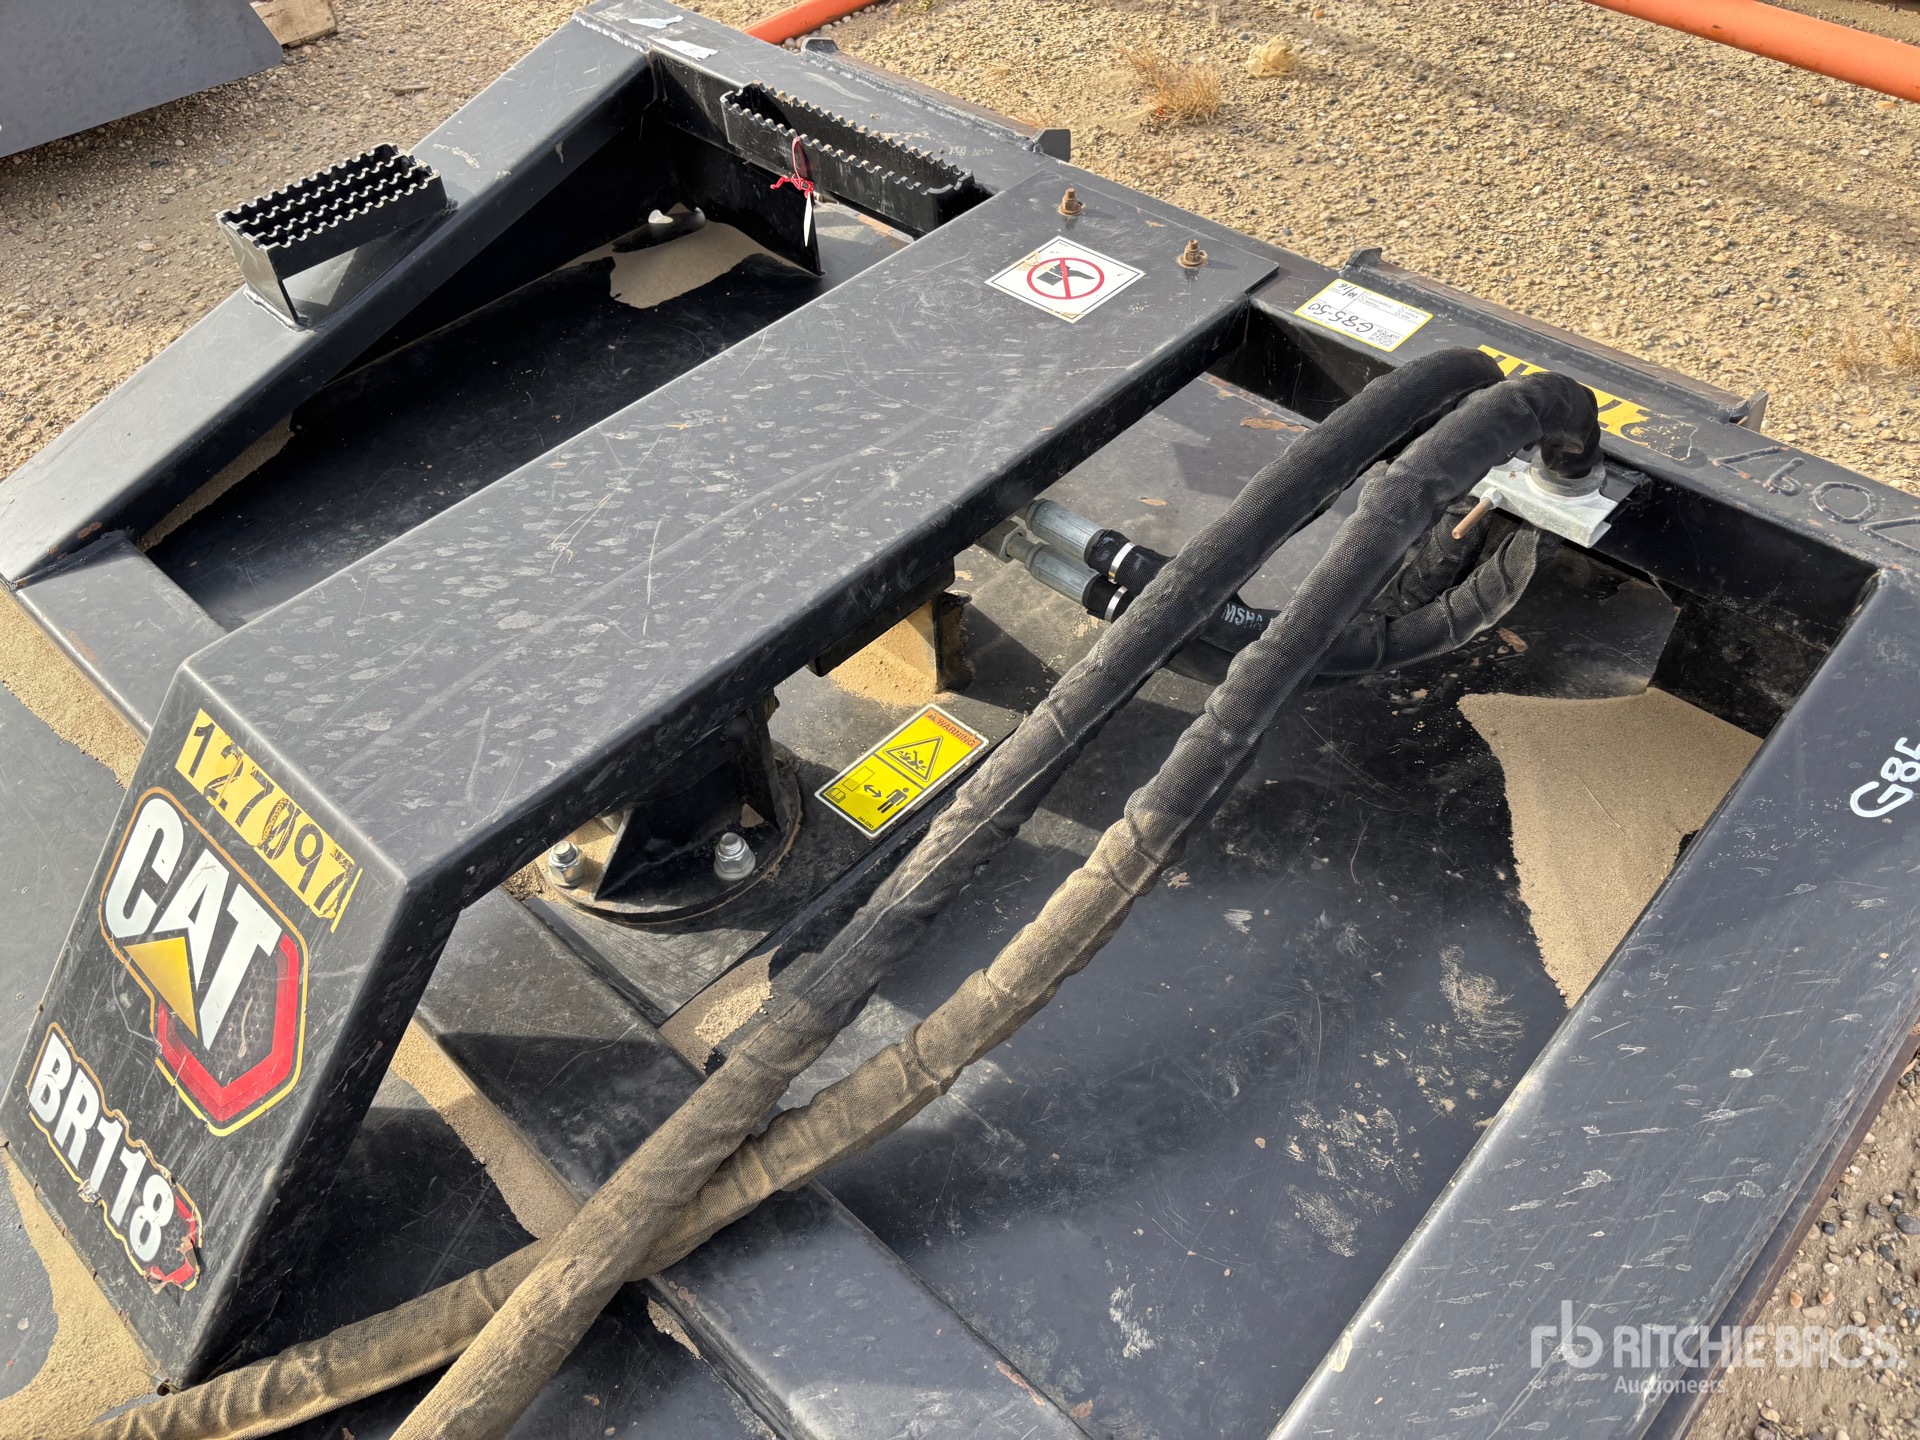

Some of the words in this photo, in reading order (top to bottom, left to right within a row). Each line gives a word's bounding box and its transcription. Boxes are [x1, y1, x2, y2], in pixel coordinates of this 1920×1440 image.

[937, 718, 976, 748] WARNING
[105, 798, 283, 1050] CAT
[28, 1030, 175, 1263] BR118
